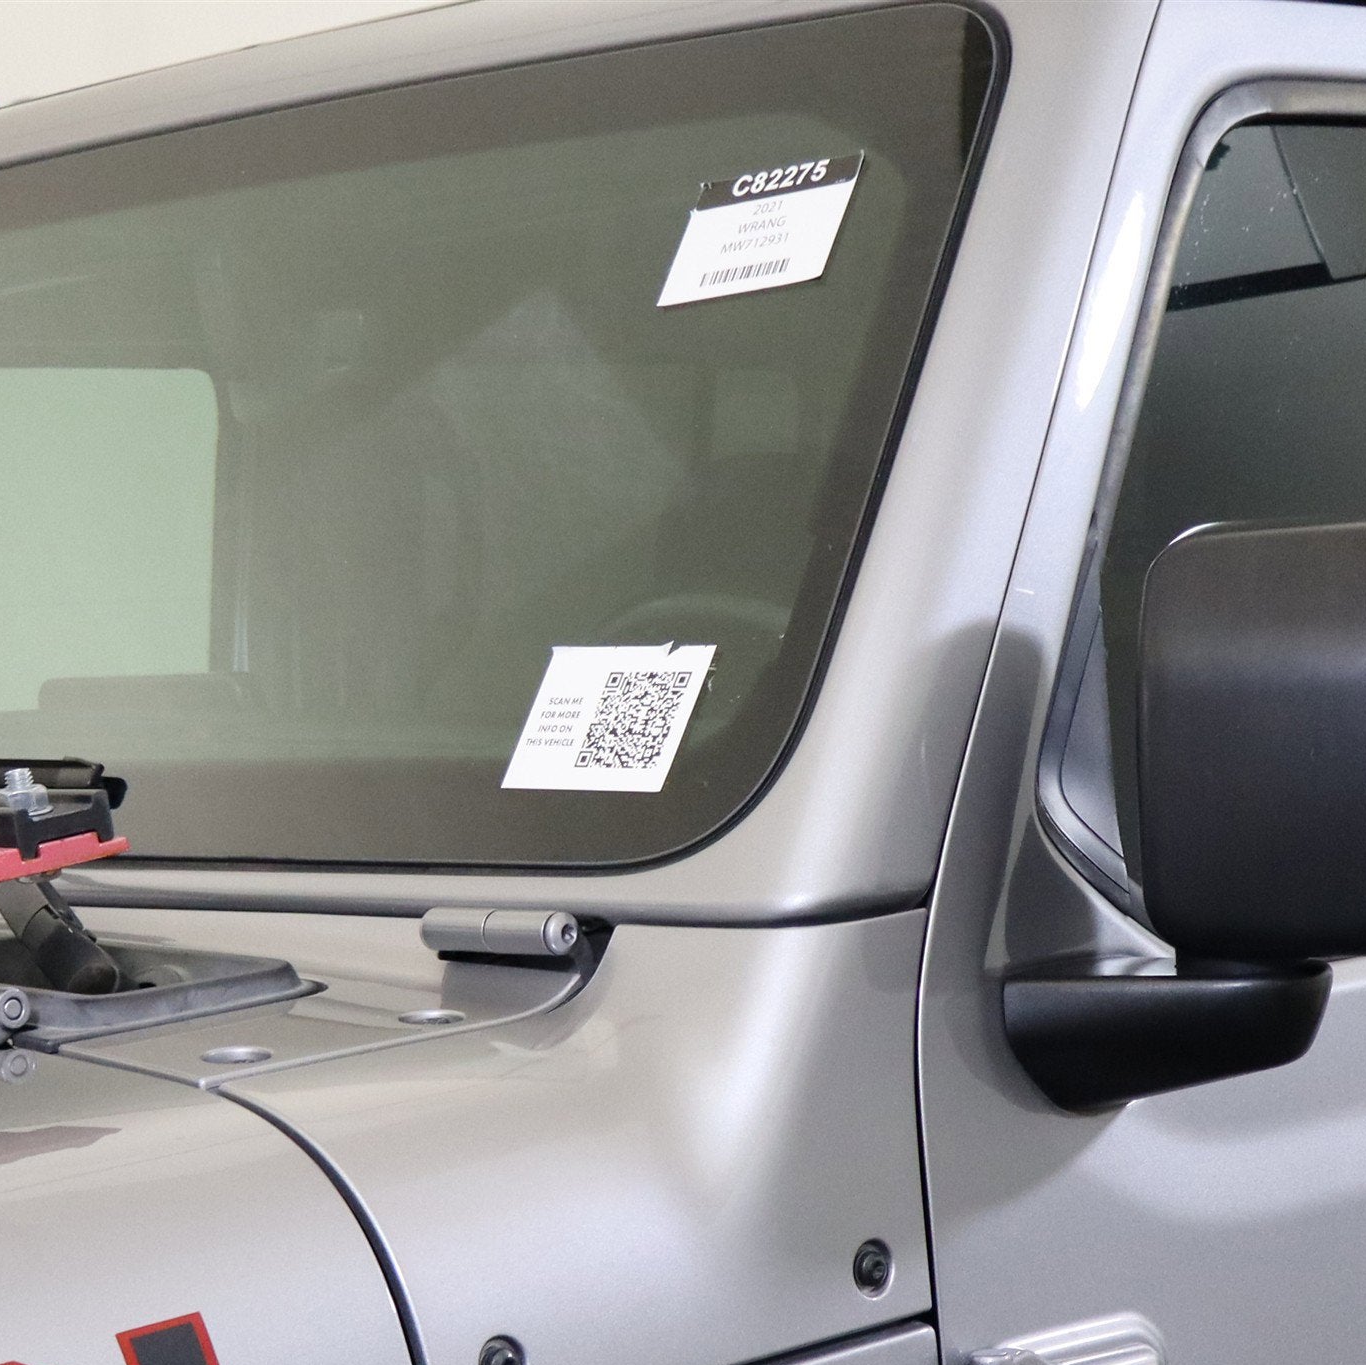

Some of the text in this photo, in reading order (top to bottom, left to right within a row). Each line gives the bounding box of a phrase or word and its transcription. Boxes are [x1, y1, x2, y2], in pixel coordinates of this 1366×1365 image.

[732, 158, 831, 197] C82275
[753, 201, 783, 215] 2021
[737, 215, 787, 234] WRANG
[720, 232, 789, 255] MW712931
[541, 711, 581, 719] FOR MORE
[538, 725, 572, 733] INFO ON
[526, 738, 574, 746] THIS VEHICLE
